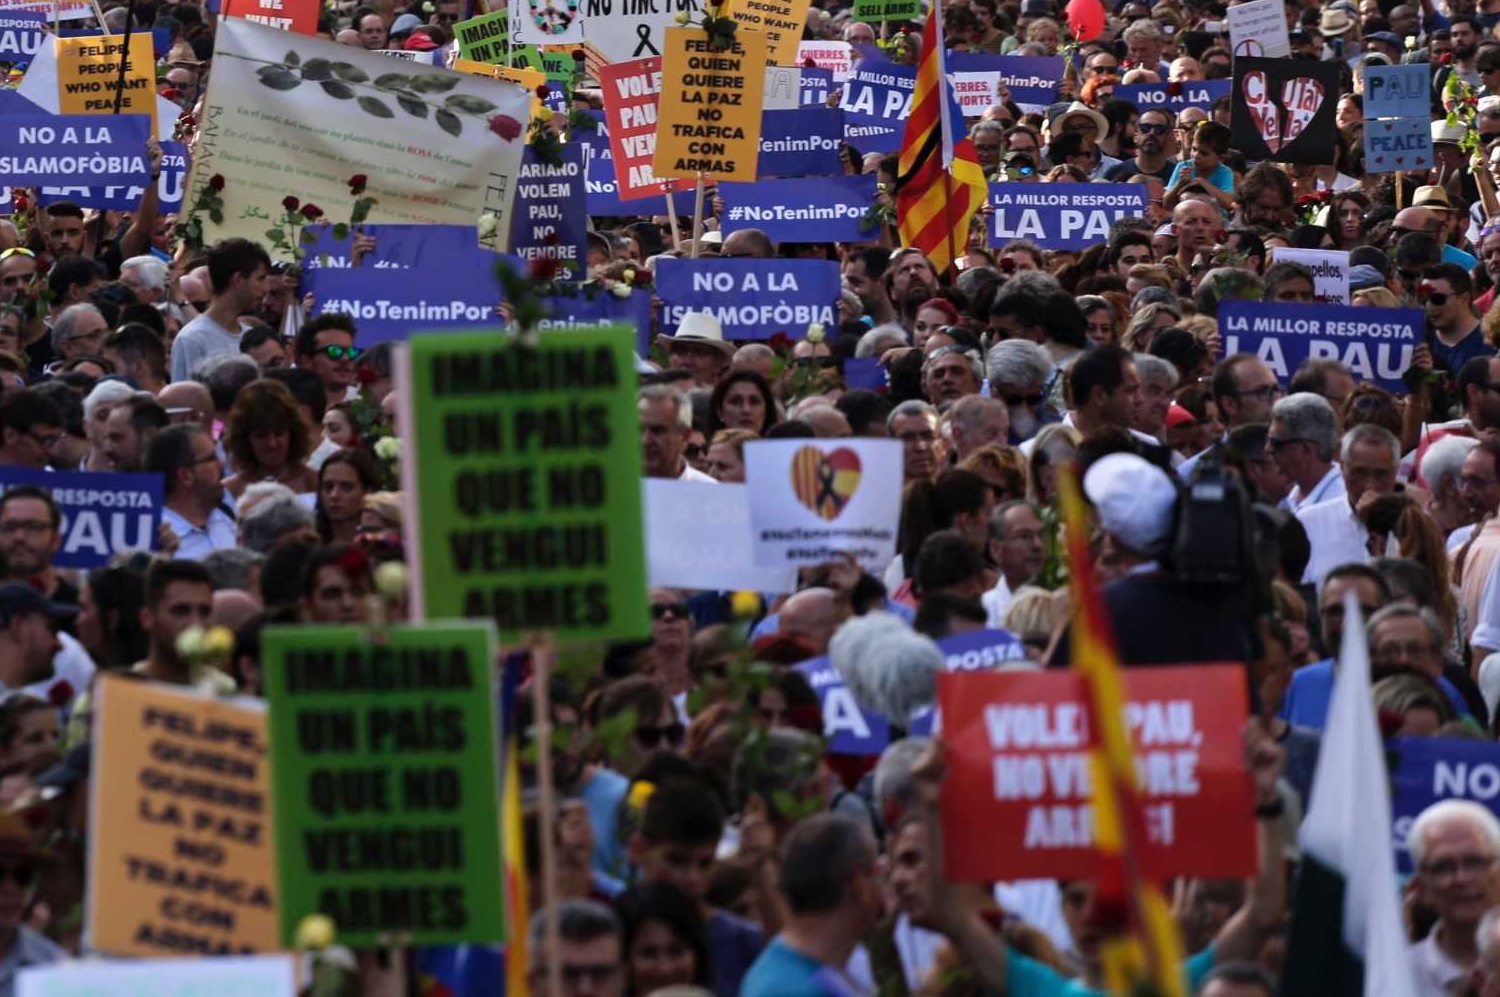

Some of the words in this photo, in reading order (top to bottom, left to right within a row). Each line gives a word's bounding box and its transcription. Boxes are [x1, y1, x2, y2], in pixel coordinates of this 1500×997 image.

[859, 3, 884, 17] SELL
[887, 2, 915, 15] ARMS
[688, 57, 740, 72] QUIEN
[682, 74, 744, 89] QUIERE
[1369, 73, 1424, 101] PAU
[682, 90, 703, 103] LA
[707, 91, 741, 105] PAZ
[697, 108, 722, 121] NO
[19, 126, 55, 145] NO
[62, 126, 80, 144] A
[84, 126, 111, 143] LA
[673, 124, 744, 139] TRAFICA
[688, 141, 724, 156] CON
[1370, 132, 1428, 152] PEACE
[407, 146, 432, 158] ROSA
[674, 157, 735, 172] ARMAS
[729, 205, 868, 221] #NoTenimPor
[693, 272, 723, 291] NO
[741, 273, 760, 290] A
[768, 273, 798, 290] LA
[321, 299, 492, 321] #NoTenimPor
[1227, 315, 1249, 331] LA
[1254, 316, 1320, 335] MILLOR
[1325, 321, 1414, 339] RESPOSTA
[1309, 340, 1415, 379] PAU
[284, 649, 474, 691] IMAGINA
[296, 711, 357, 754] UN
[368, 701, 466, 751] PAÍS
[308, 769, 390, 818] QUE
[405, 769, 462, 810] NO
[303, 828, 463, 873] VENGUI
[320, 886, 466, 931] ARMES
